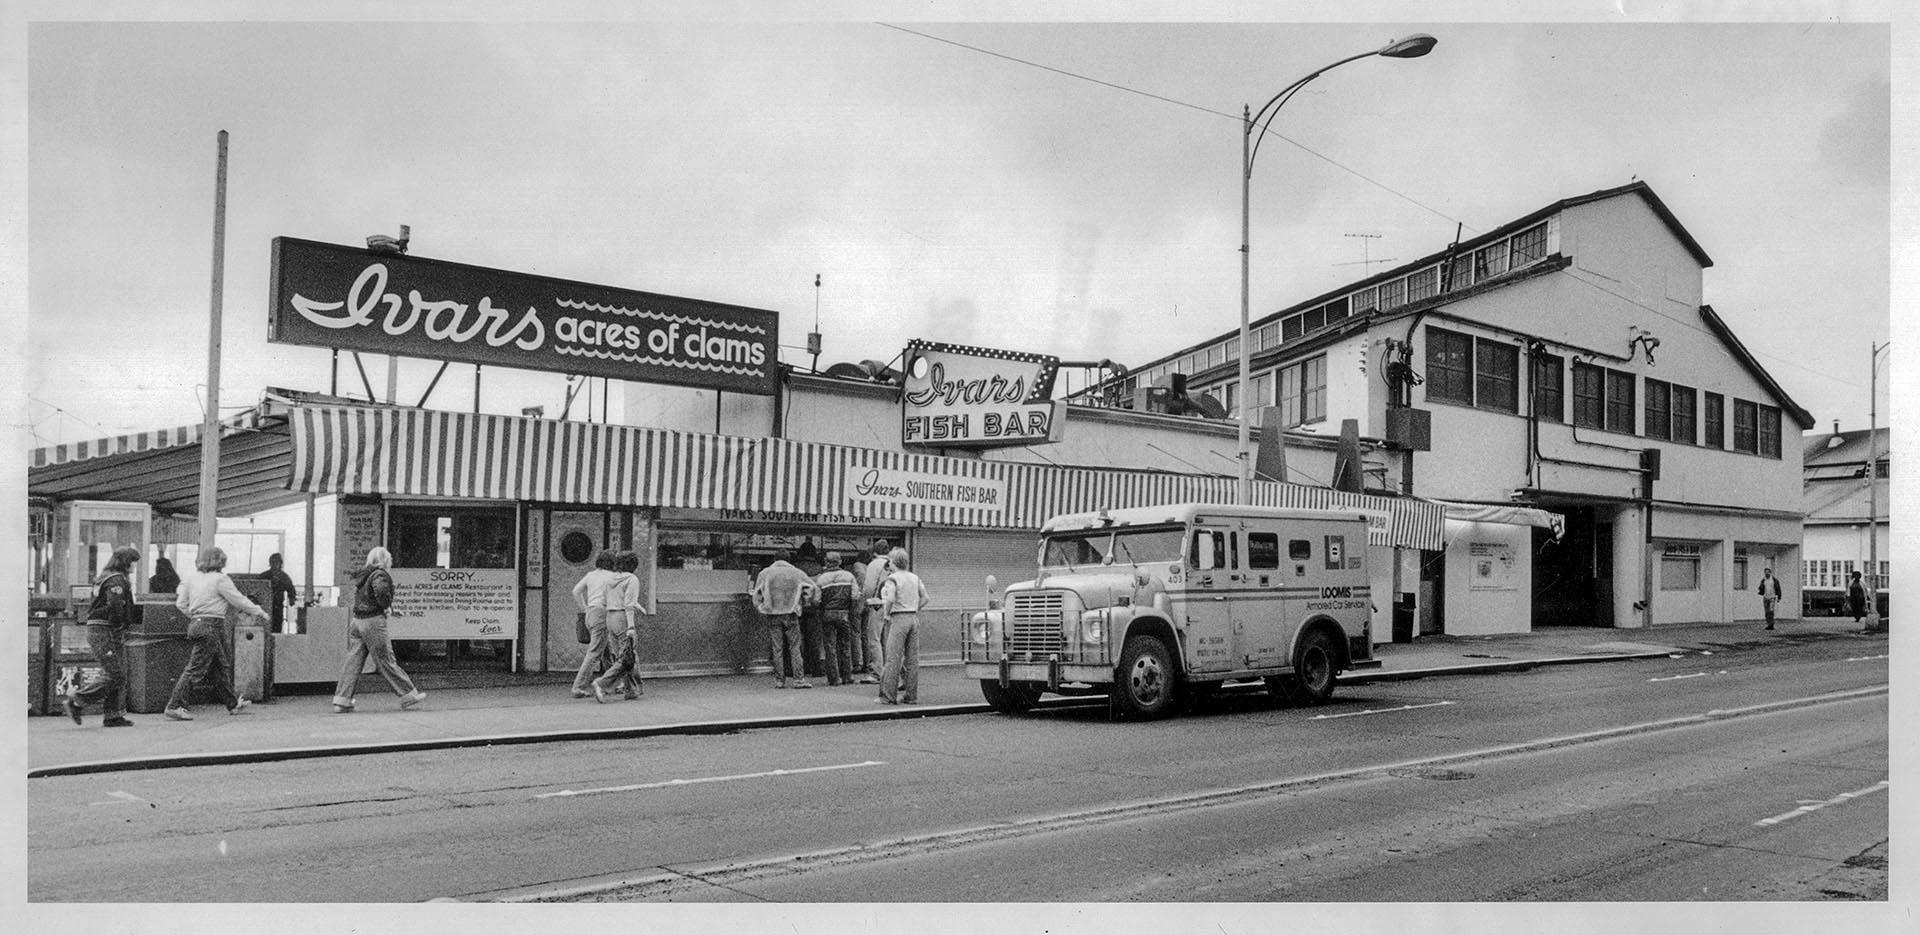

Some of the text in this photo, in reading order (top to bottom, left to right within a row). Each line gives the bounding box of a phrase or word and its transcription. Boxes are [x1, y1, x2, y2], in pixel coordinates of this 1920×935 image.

[291, 263, 546, 351] Ivars
[555, 314, 765, 366] acres of clams
[906, 361, 1025, 407] Ivars
[905, 410, 1048, 440] FISH BAR
[856, 469, 998, 505] Ivars SOUTHERN FISH BAR
[1168, 575, 1182, 584] 403
[1321, 586, 1352, 599] LOOMIS
[1306, 600, 1365, 611] Armored Car Service
